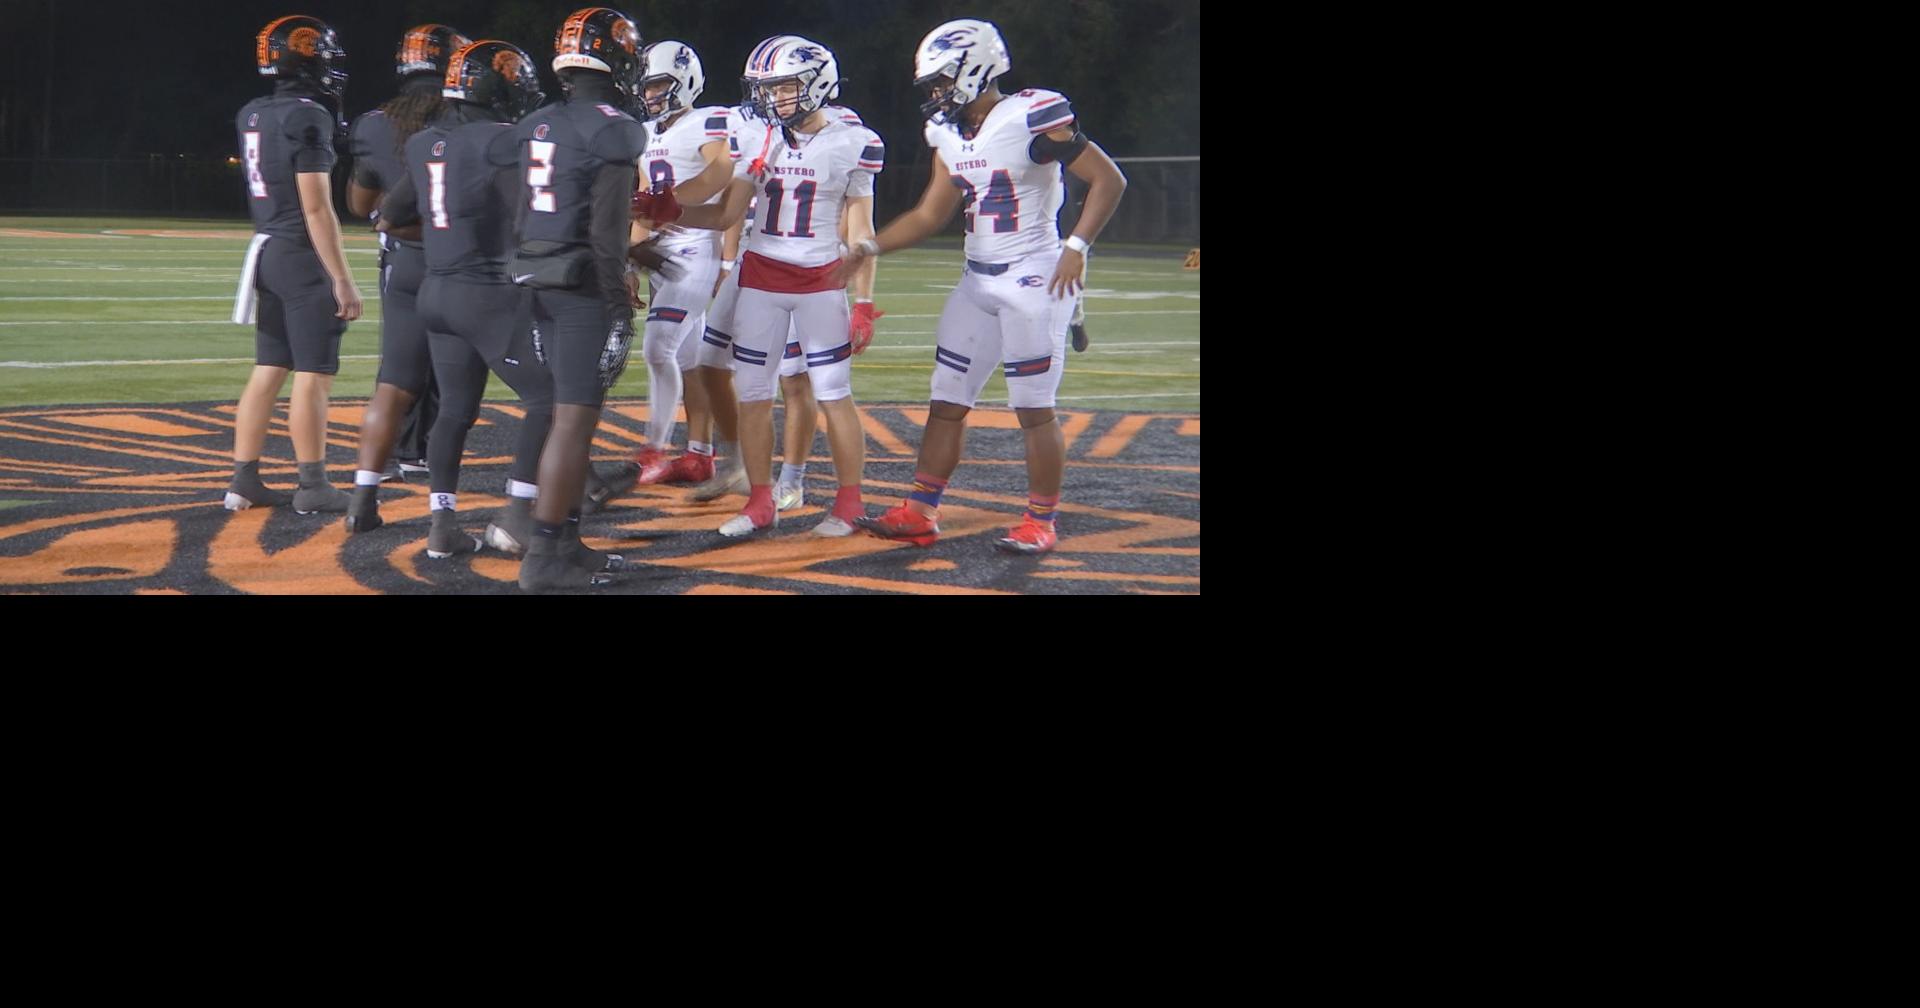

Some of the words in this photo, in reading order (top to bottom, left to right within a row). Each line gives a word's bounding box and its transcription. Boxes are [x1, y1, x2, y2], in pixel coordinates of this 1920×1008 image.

[424, 161, 450, 230] 1
[528, 139, 558, 214] 2
[955, 159, 987, 171] ESTERO
[760, 177, 817, 238] 11
